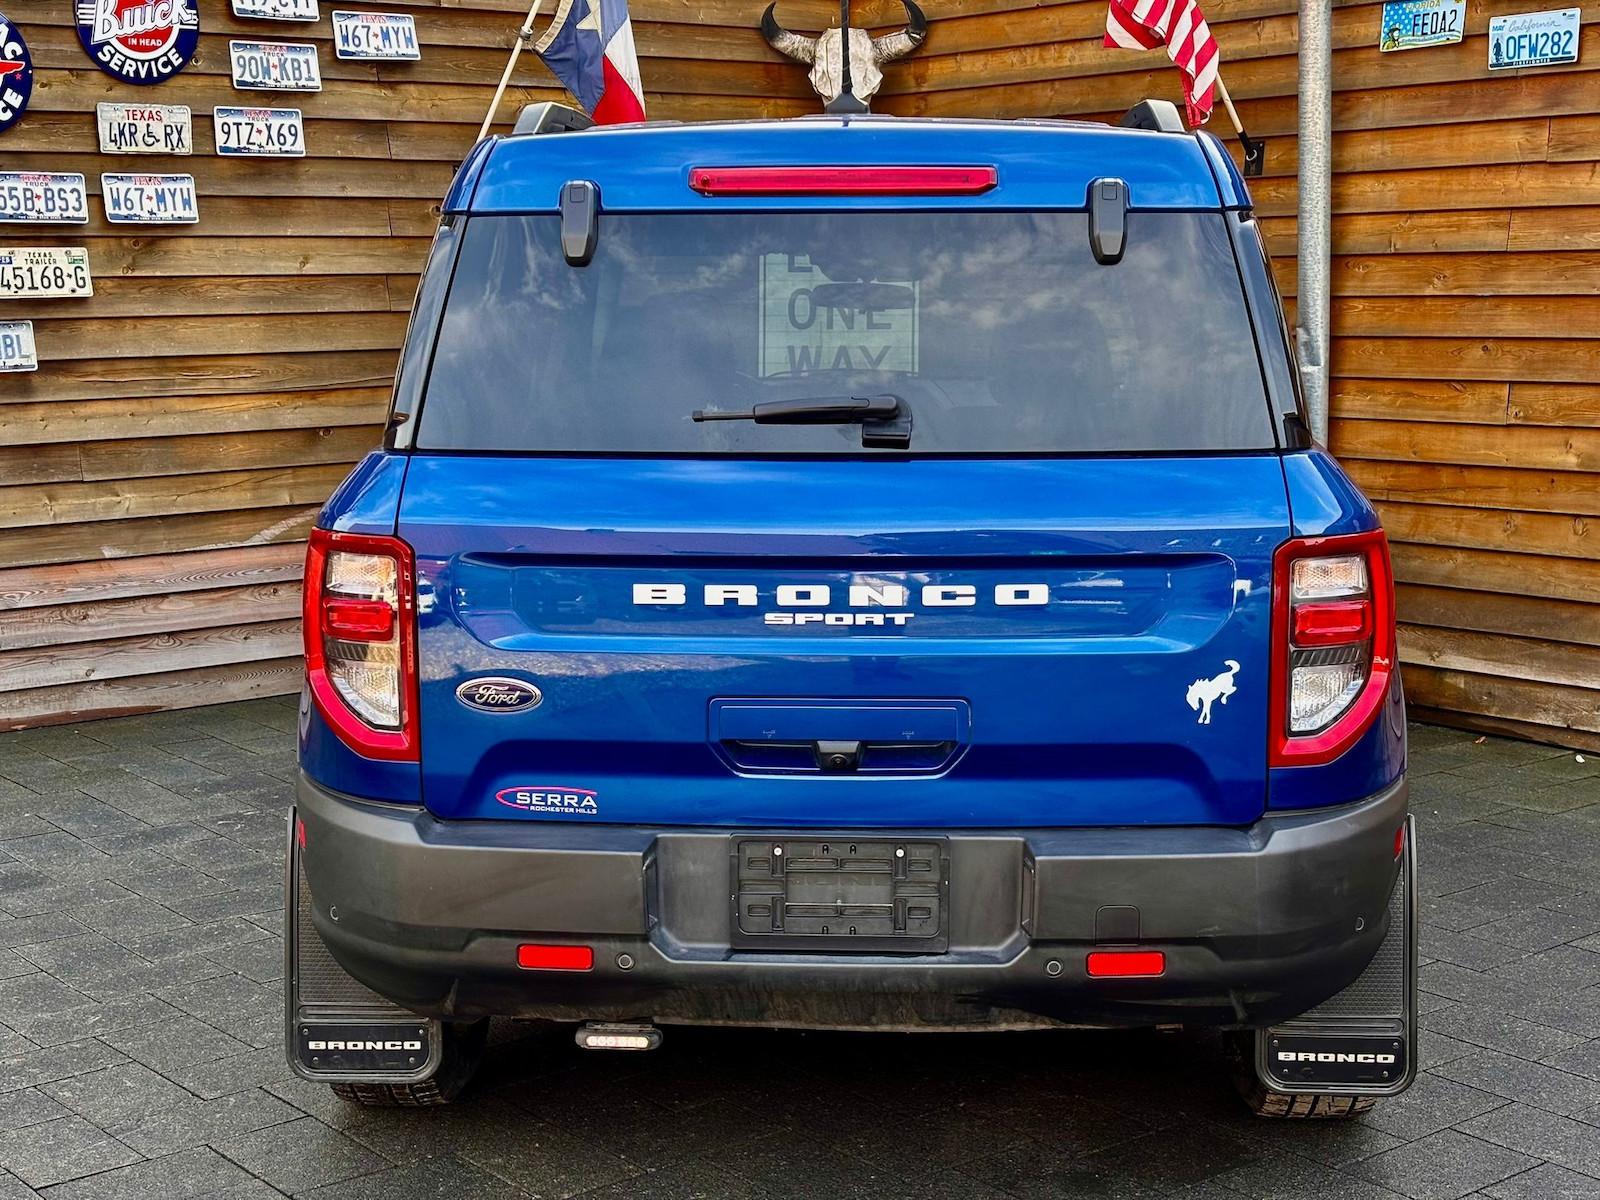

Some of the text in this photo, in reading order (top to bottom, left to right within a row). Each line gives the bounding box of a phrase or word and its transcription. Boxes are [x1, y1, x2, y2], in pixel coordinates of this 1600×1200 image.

[91, 0, 199, 44] Buick
[1508, 17, 1561, 33] California
[128, 37, 163, 47] IN HEAD
[338, 24, 415, 49] W67 MYW
[97, 48, 183, 79] SERVICE
[125, 109, 162, 122] TEXAS
[109, 122, 186, 149] 4KR RX
[221, 121, 298, 147] 9TZ X69
[43, 187, 83, 212] BS3
[109, 187, 193, 212] W67 MYW
[0, 265, 87, 290] 45168 G
[788, 287, 892, 330] ONE
[0, 333, 30, 360] BL
[787, 345, 892, 370] WAY
[632, 583, 1049, 607] BRONCO
[764, 612, 915, 625] SPORT
[474, 684, 520, 705] Ford
[516, 792, 597, 808] SERRA
[530, 805, 575, 813] ROCHESTER
[308, 1040, 422, 1050] BRONCO
[1277, 1051, 1395, 1064] BRONCO
